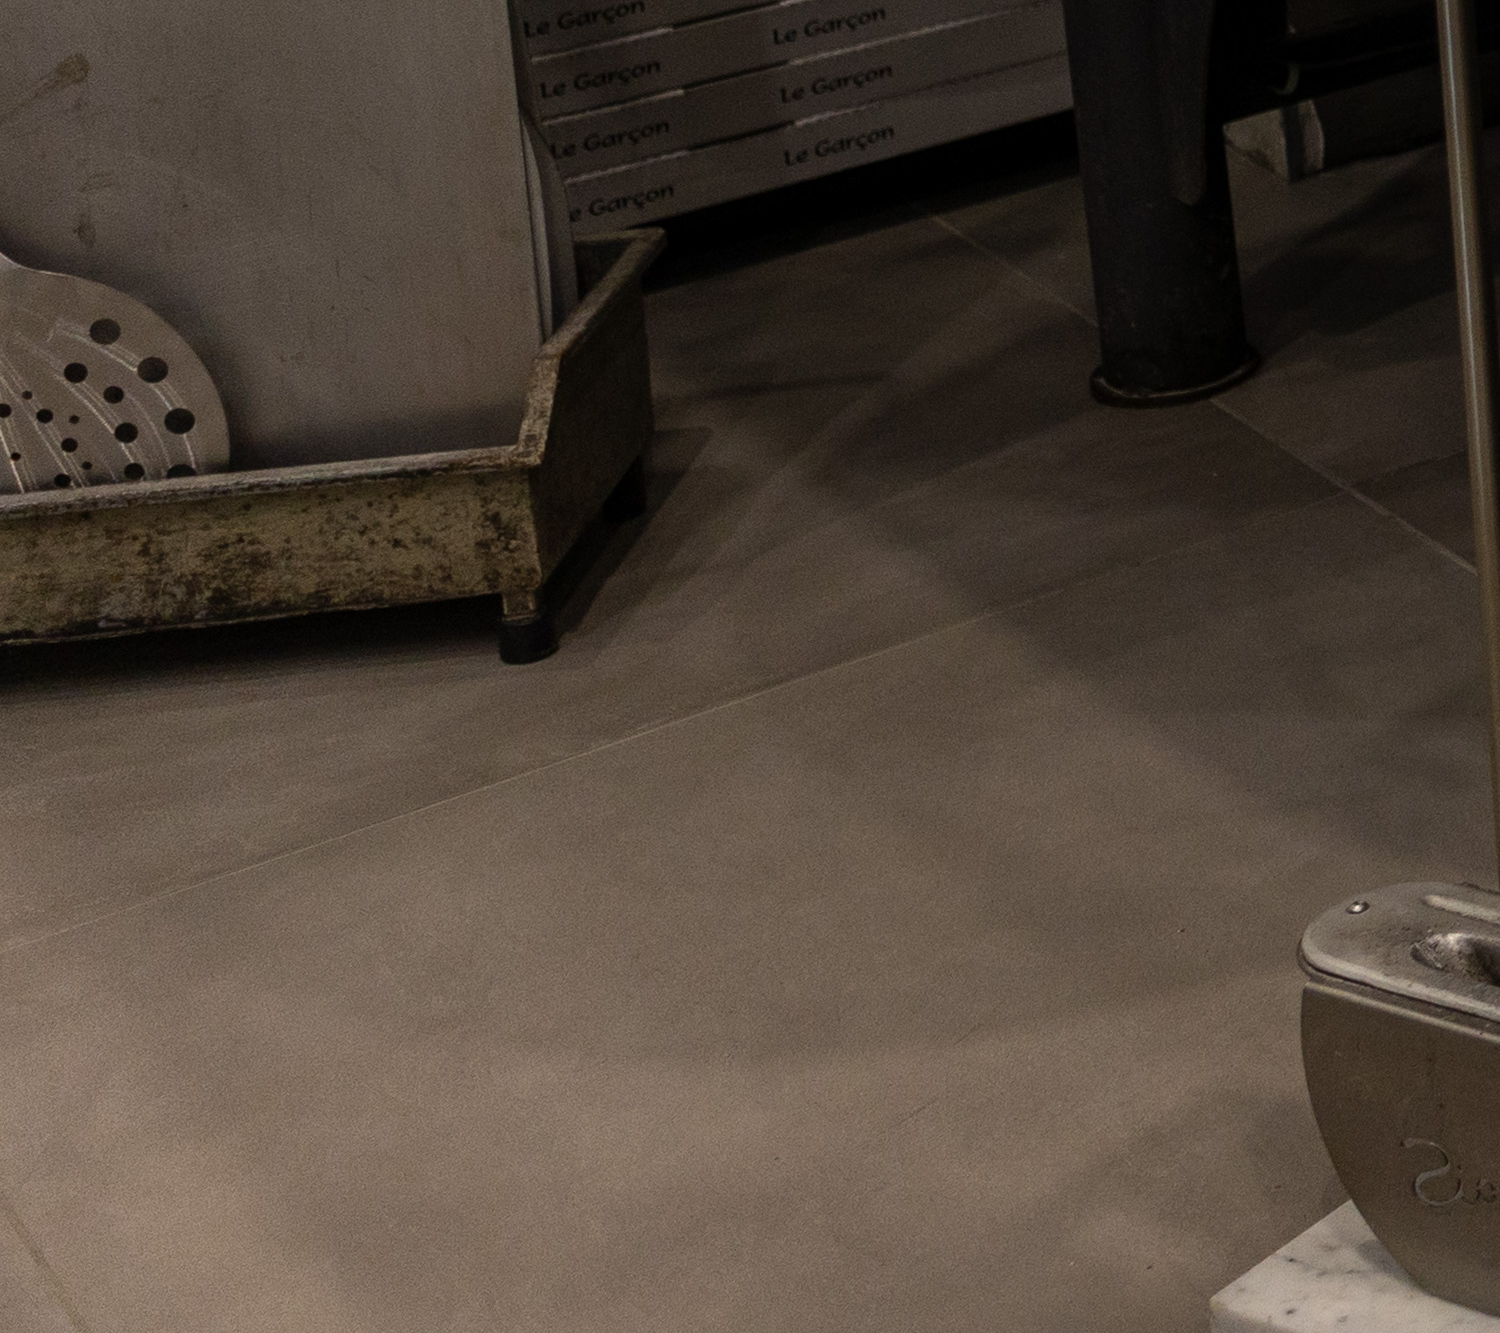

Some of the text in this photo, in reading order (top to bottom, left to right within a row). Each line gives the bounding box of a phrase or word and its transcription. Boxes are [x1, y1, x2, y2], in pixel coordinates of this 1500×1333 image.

[523, 0, 645, 38] Le Garçon
[773, 7, 886, 45] Le Garçon
[540, 61, 661, 98] Le Garçon
[778, 66, 895, 103] Le Garçon
[550, 121, 669, 160] Le Garçon
[783, 126, 895, 166] Le Garçon
[588, 184, 676, 216] Garçon
